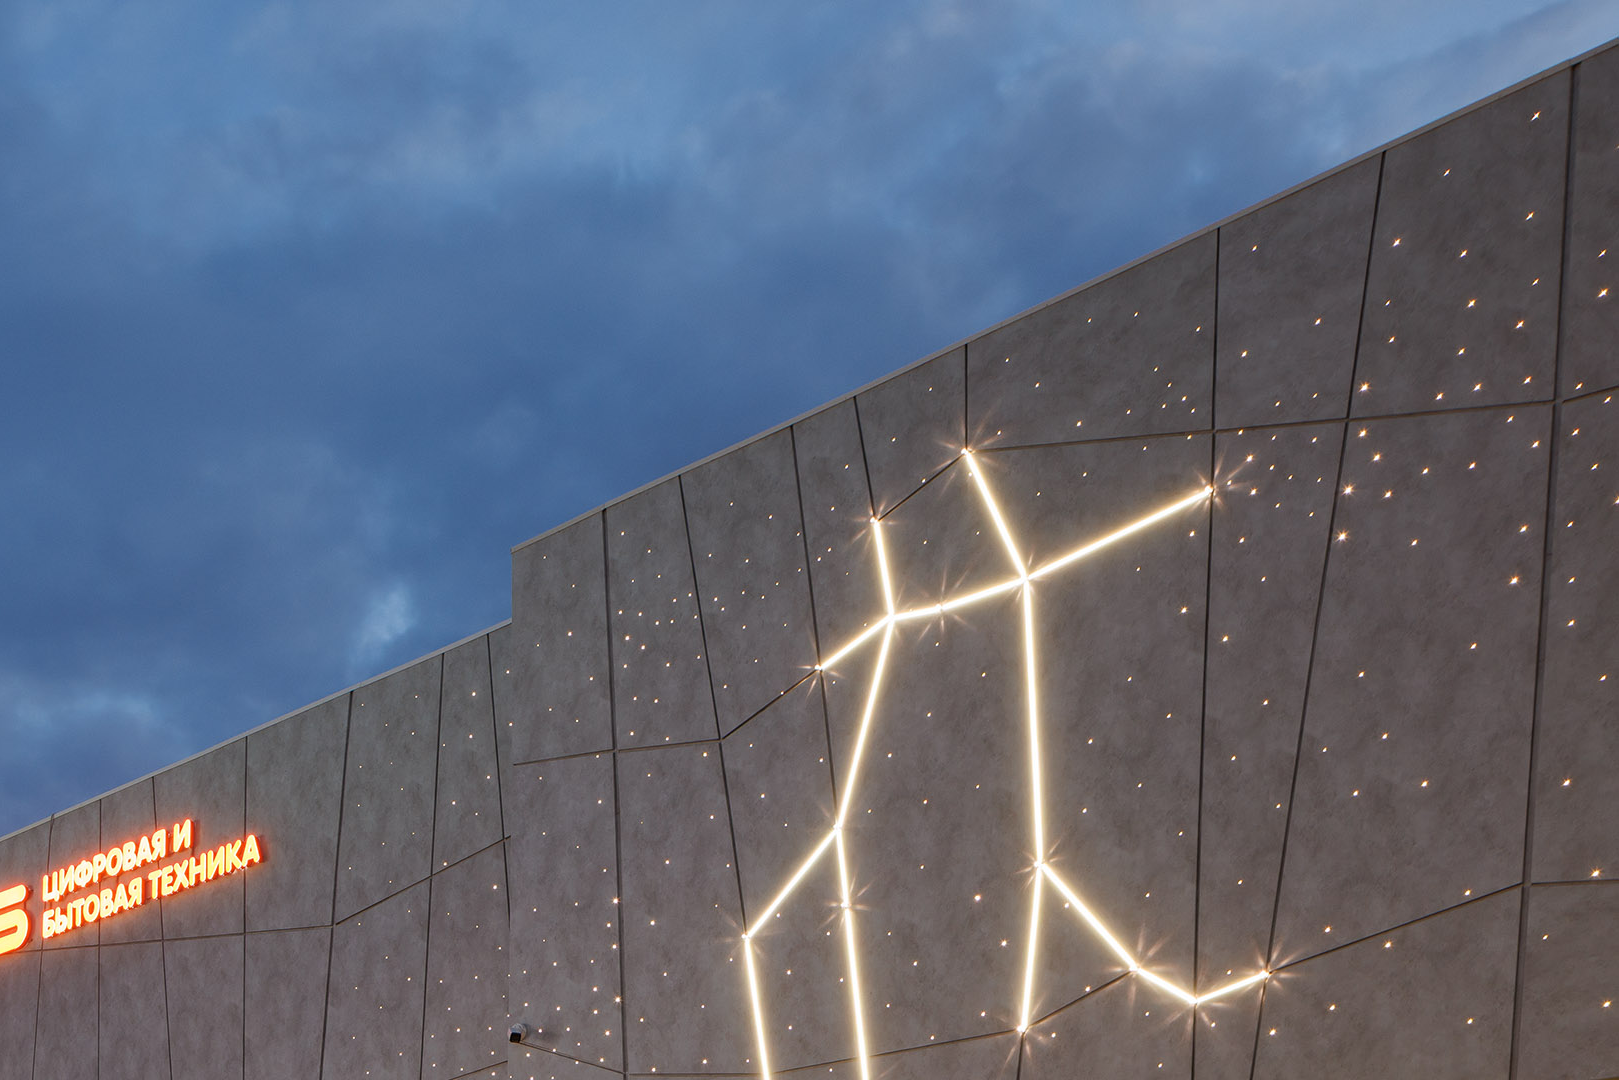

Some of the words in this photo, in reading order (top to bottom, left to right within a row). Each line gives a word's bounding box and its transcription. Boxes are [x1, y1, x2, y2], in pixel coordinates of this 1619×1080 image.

[42, 828, 166, 902] ЦИФРОВАЯ
[173, 819, 193, 852] И
[42, 876, 143, 938] БЫТОВАЯ
[148, 834, 261, 900] ТЕХНИКА
